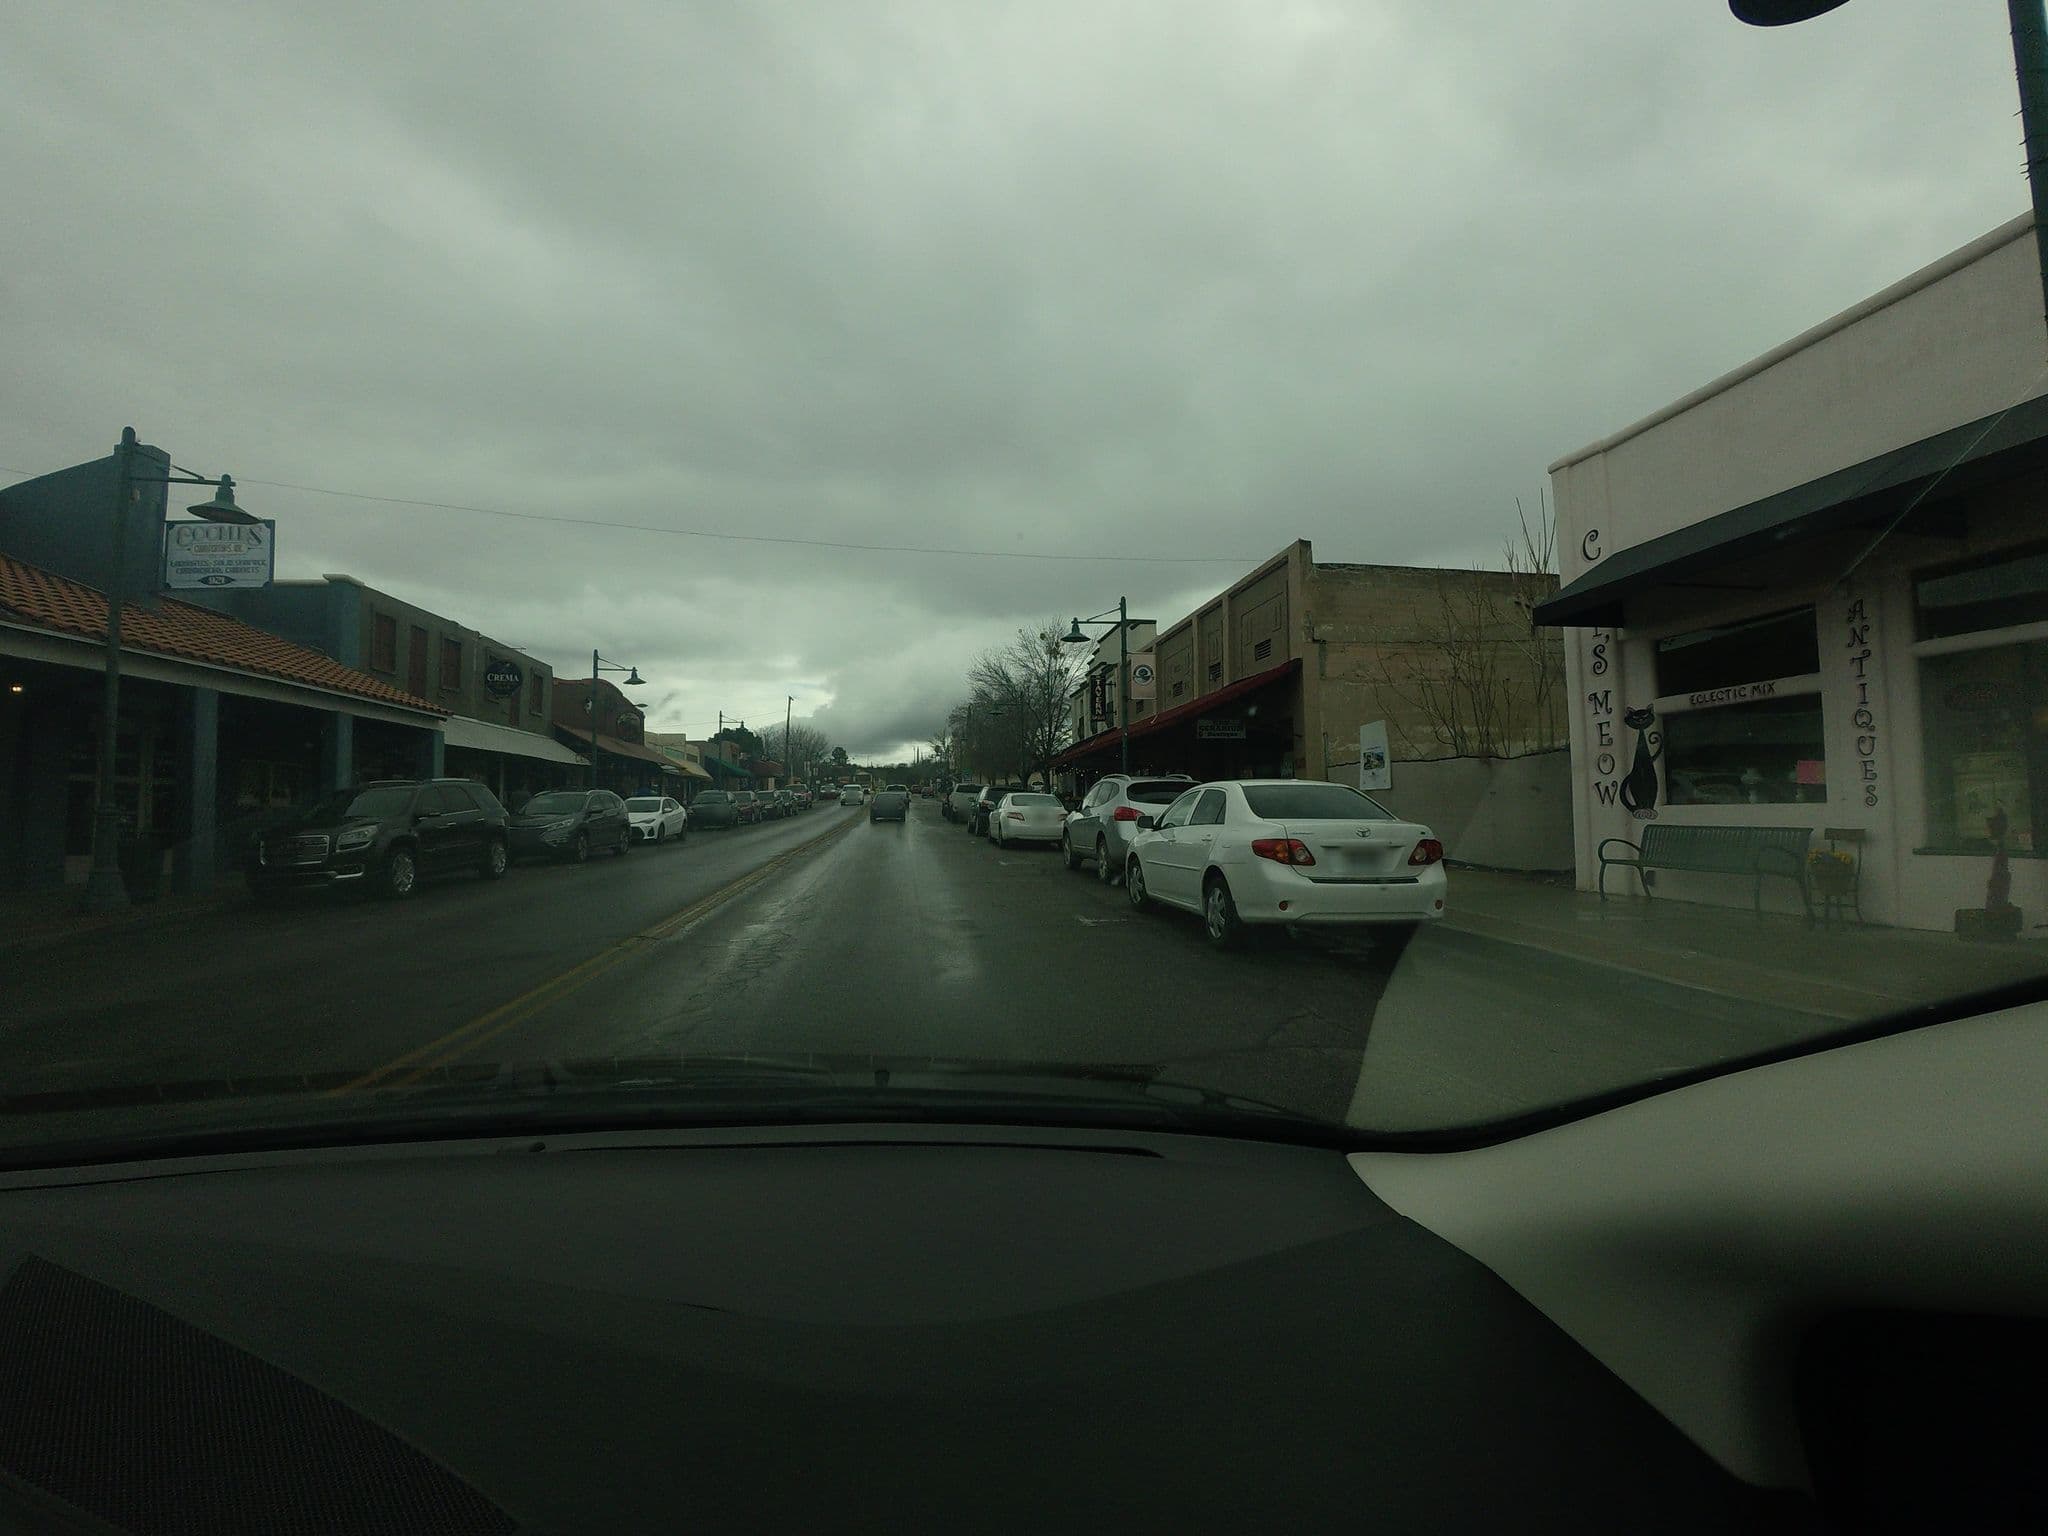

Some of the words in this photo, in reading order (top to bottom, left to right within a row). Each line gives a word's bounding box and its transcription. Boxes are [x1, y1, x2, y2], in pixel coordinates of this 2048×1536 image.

[487, 673, 520, 682] CREMA
[1689, 684, 1748, 706] ECLECTIC
[1751, 681, 1776, 698] MIX
[1847, 598, 1879, 808] ANTIQUES
[1588, 689, 1618, 807] MEOW
